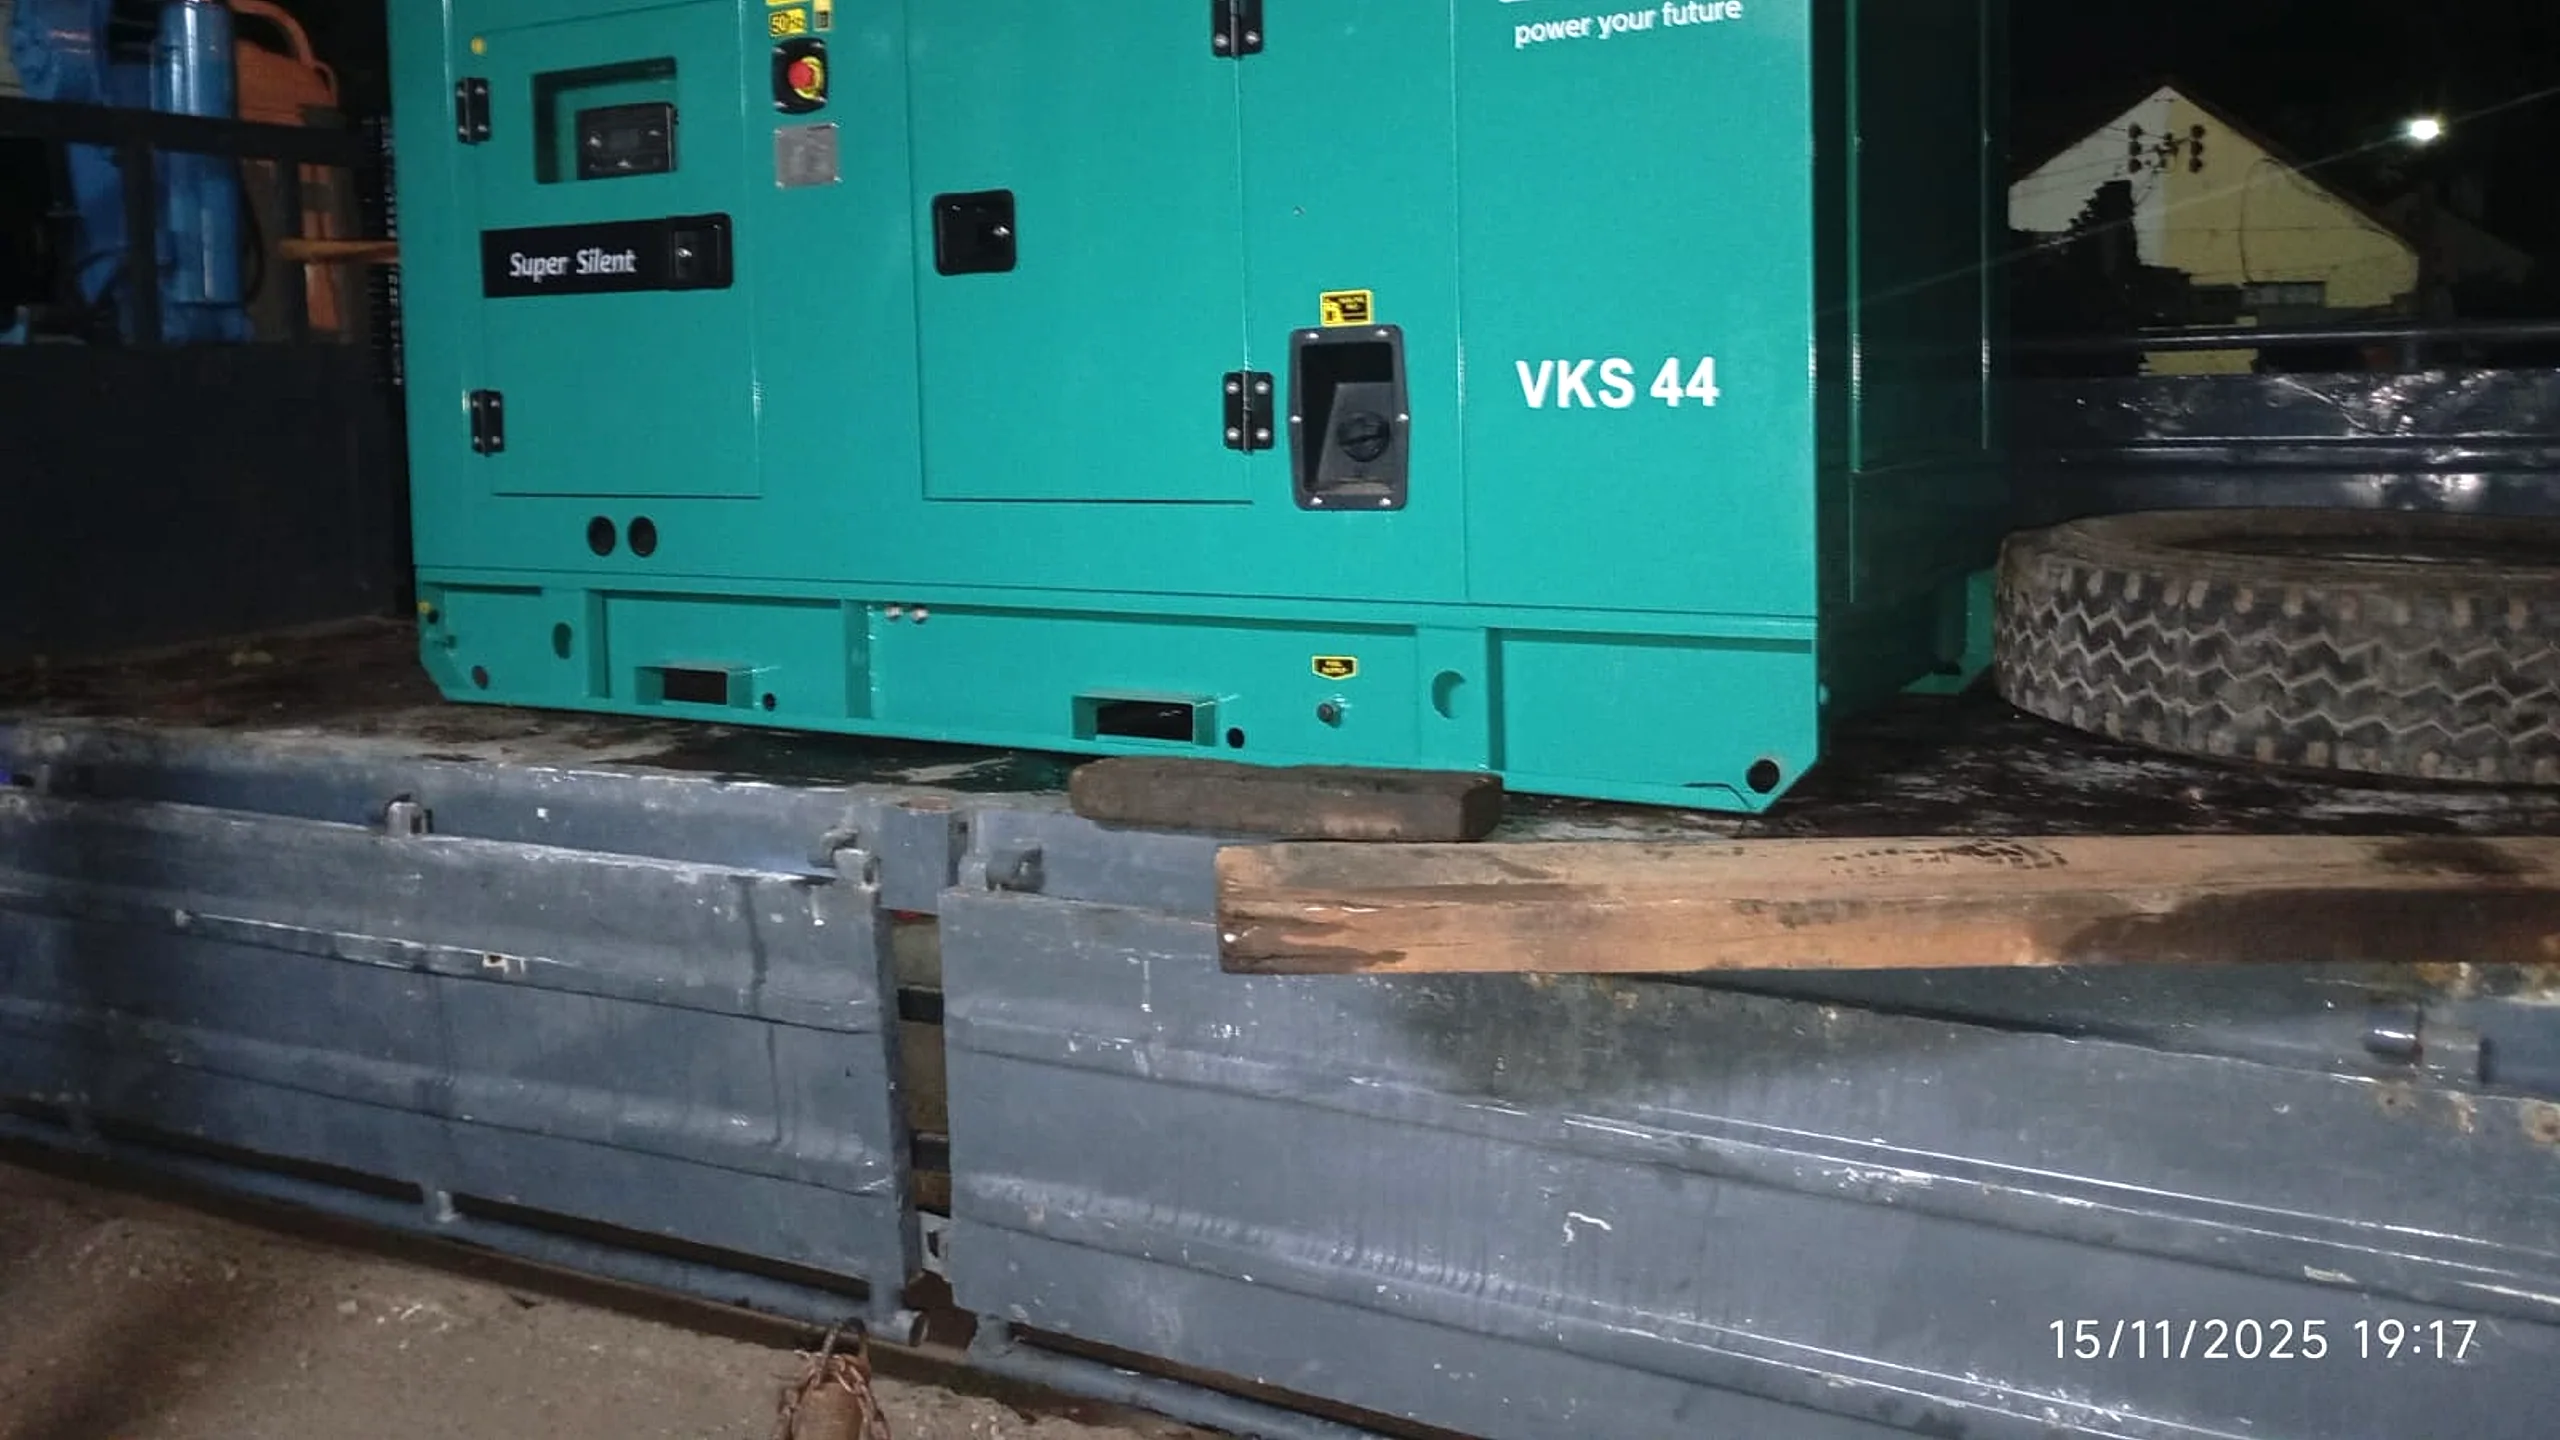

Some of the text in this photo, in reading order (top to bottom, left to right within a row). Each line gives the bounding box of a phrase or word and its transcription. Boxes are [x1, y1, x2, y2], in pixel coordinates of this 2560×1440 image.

[1515, 0, 1744, 49] power your future
[509, 247, 636, 283] Super Silent
[1515, 356, 1720, 409] VKS 44
